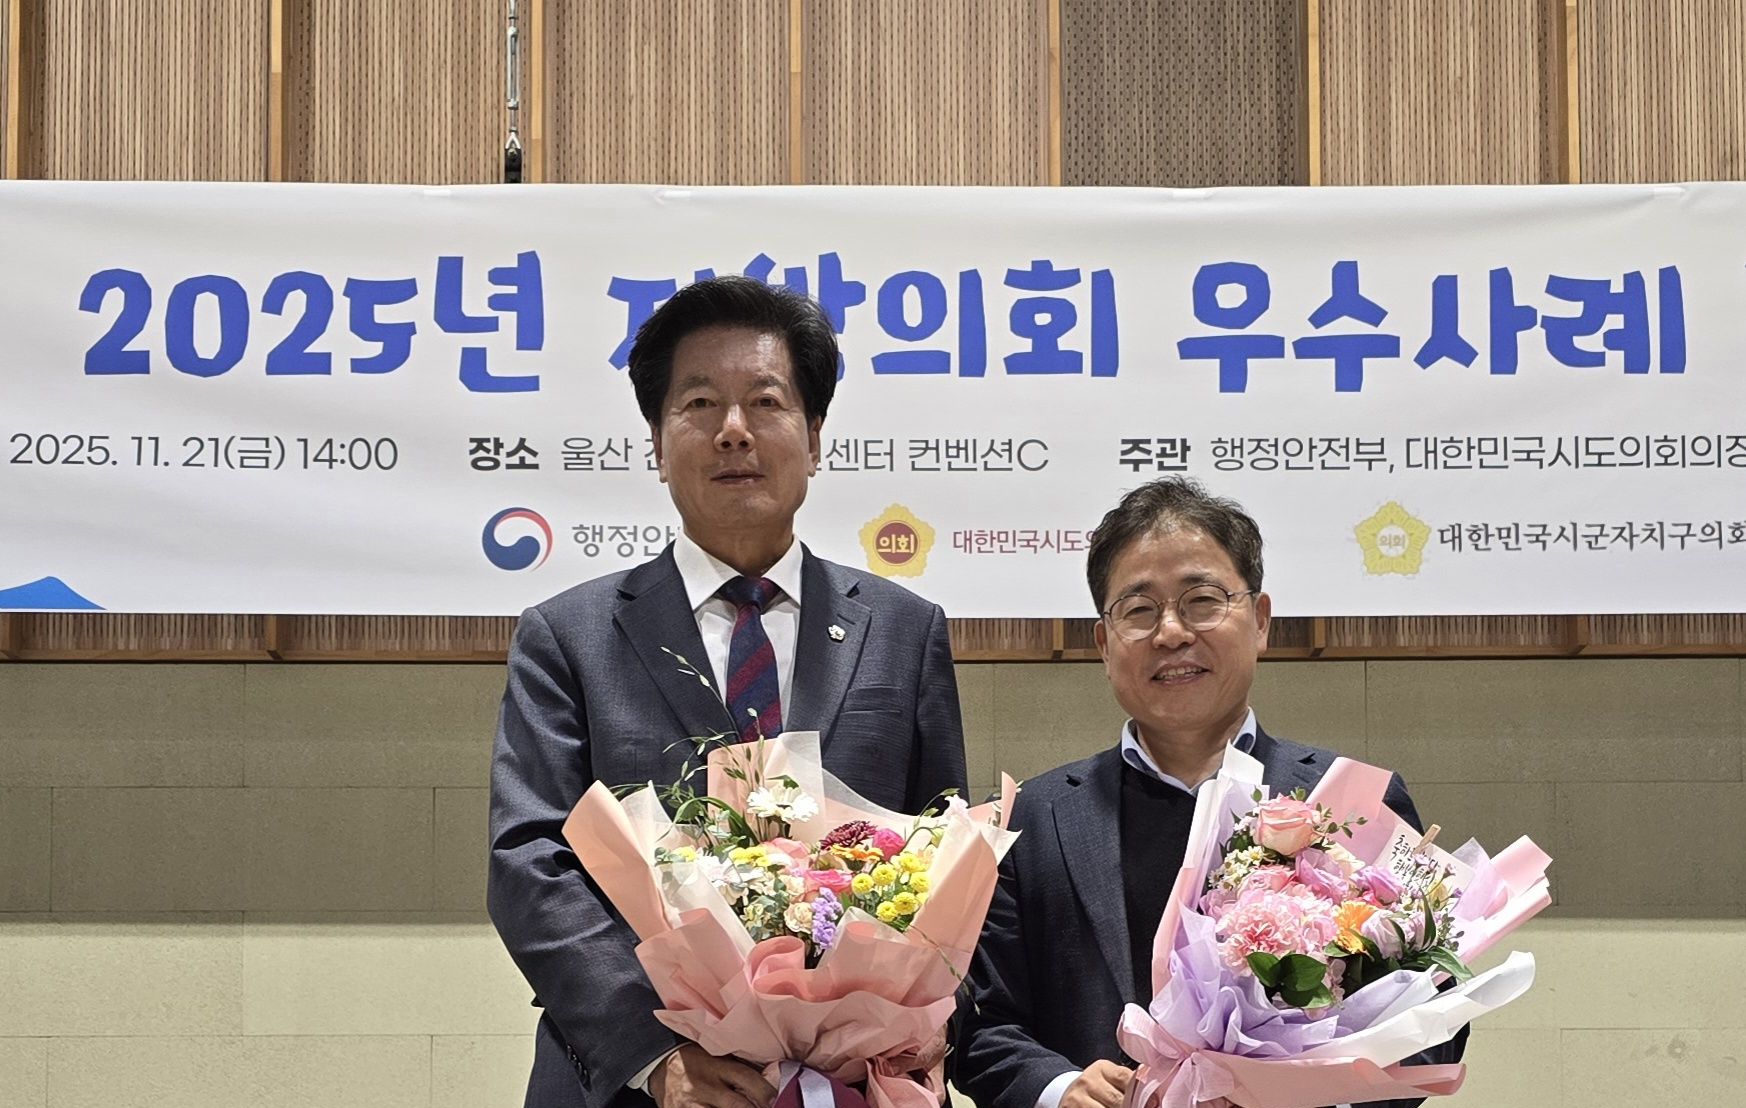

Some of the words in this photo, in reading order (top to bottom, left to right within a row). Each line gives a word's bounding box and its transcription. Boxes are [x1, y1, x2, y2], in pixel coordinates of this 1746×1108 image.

[79, 250, 545, 393] 2025년
[607, 251, 1120, 384] 의회
[1177, 260, 1687, 394] 우수사례
[9, 433, 118, 466] 2025.
[131, 436, 170, 467] 11.
[182, 435, 286, 470] 21(금)
[297, 437, 399, 471] 14:00
[468, 437, 540, 471] 장소
[561, 437, 633, 471] 울산
[908, 438, 1049, 472] 컨벤션C
[1119, 438, 1191, 472] 주관
[1210, 437, 1396, 474] 행정안전부,
[572, 524, 681, 558] 행정안
[877, 534, 915, 554] 의회
